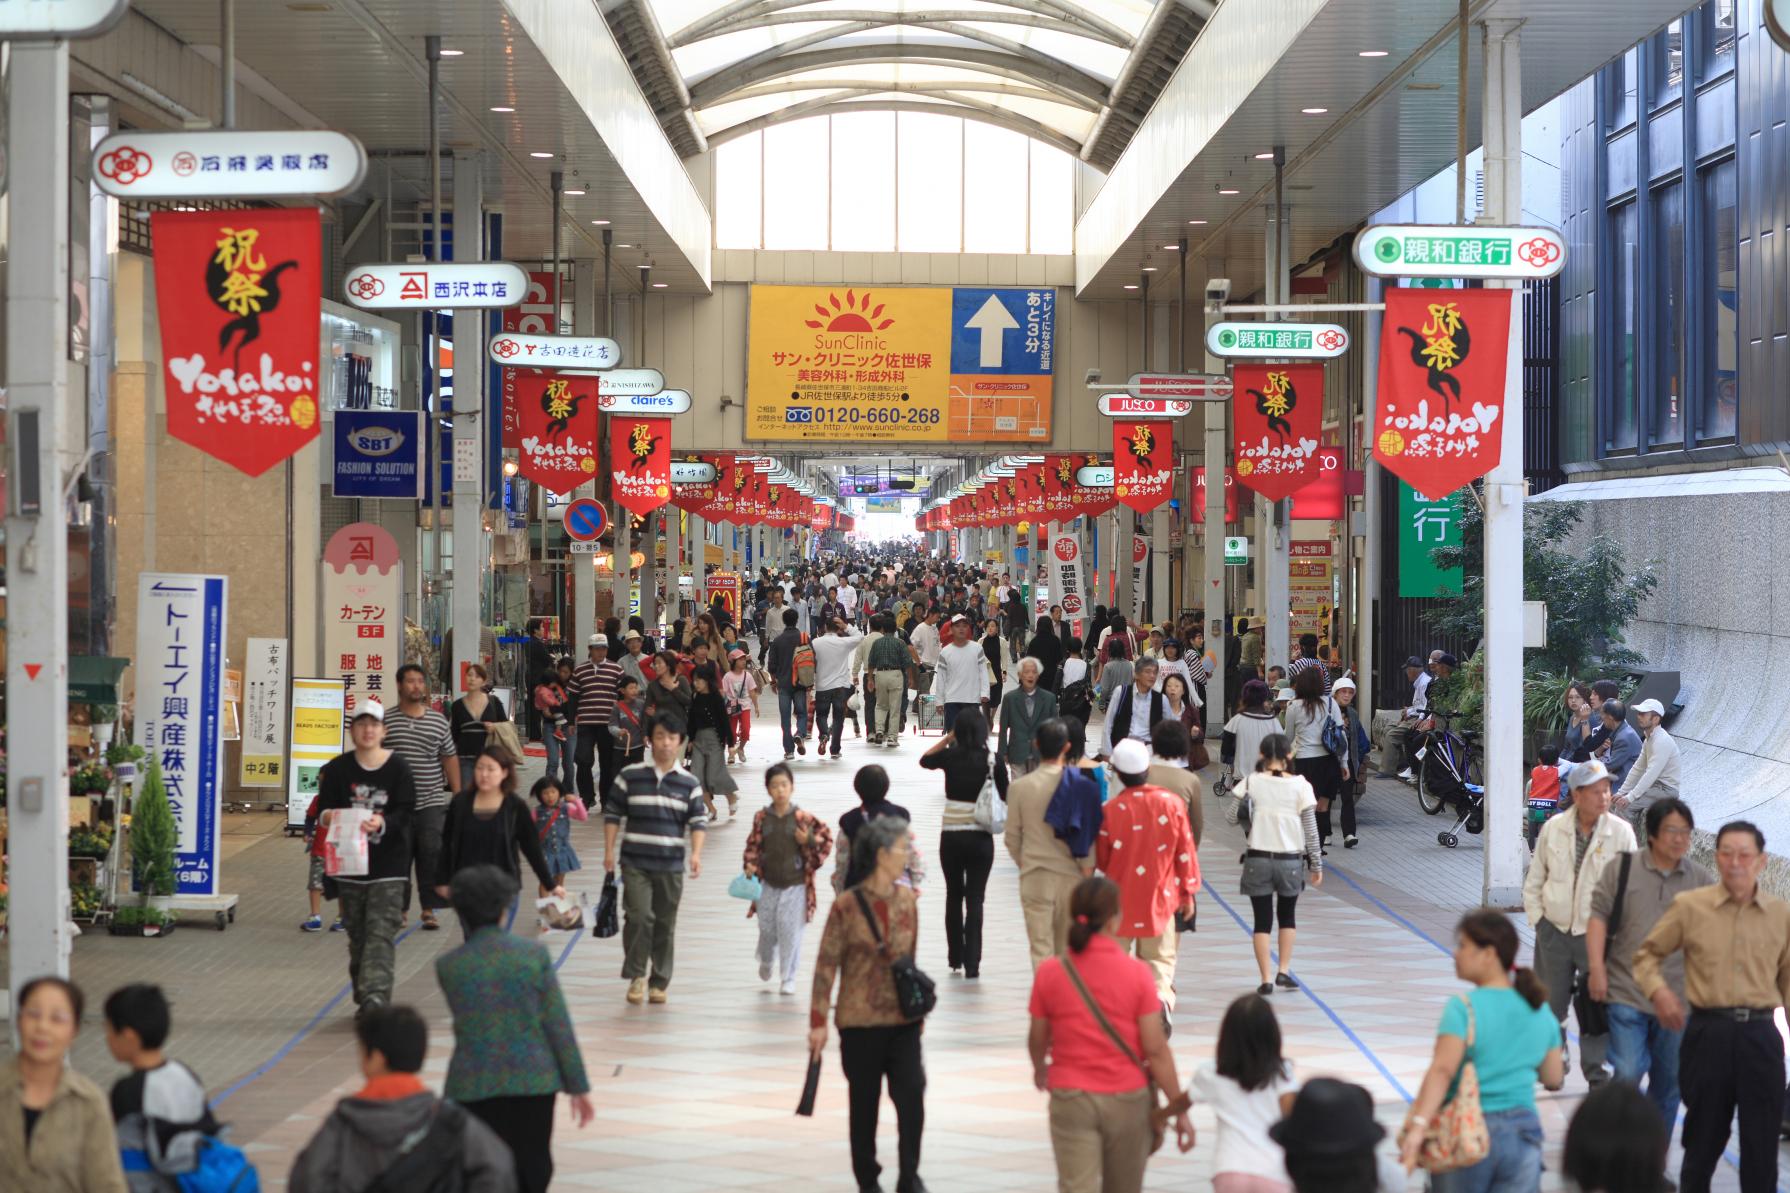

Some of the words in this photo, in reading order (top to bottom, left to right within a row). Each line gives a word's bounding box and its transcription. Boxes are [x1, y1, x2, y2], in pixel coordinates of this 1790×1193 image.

[1404, 239, 1511, 264] 親和銀行
[434, 281, 507, 299] 西沢本店
[1025, 292, 1041, 353] あと3分
[1040, 292, 1053, 370] キレイになる近道
[814, 334, 887, 350] SunClinic
[1239, 330, 1312, 349] 親和銀行
[772, 352, 933, 369] サン・クリニック佐世保
[169, 353, 313, 396] Yosakoi
[797, 369, 905, 384] 美容外科・形成外科
[631, 395, 674, 407] claire's
[1120, 399, 1155, 412] JUSCO
[815, 407, 940, 424] 0120-660-268
[358, 436, 393, 451] SBT
[521, 436, 594, 457] Yosakoi
[337, 462, 373, 475] FASHION
[375, 462, 415, 475] SOLUTION
[340, 604, 385, 620] カーテン
[264, 644, 280, 745] 古布パッチワーク展
[246, 762, 279, 775] 中2階
